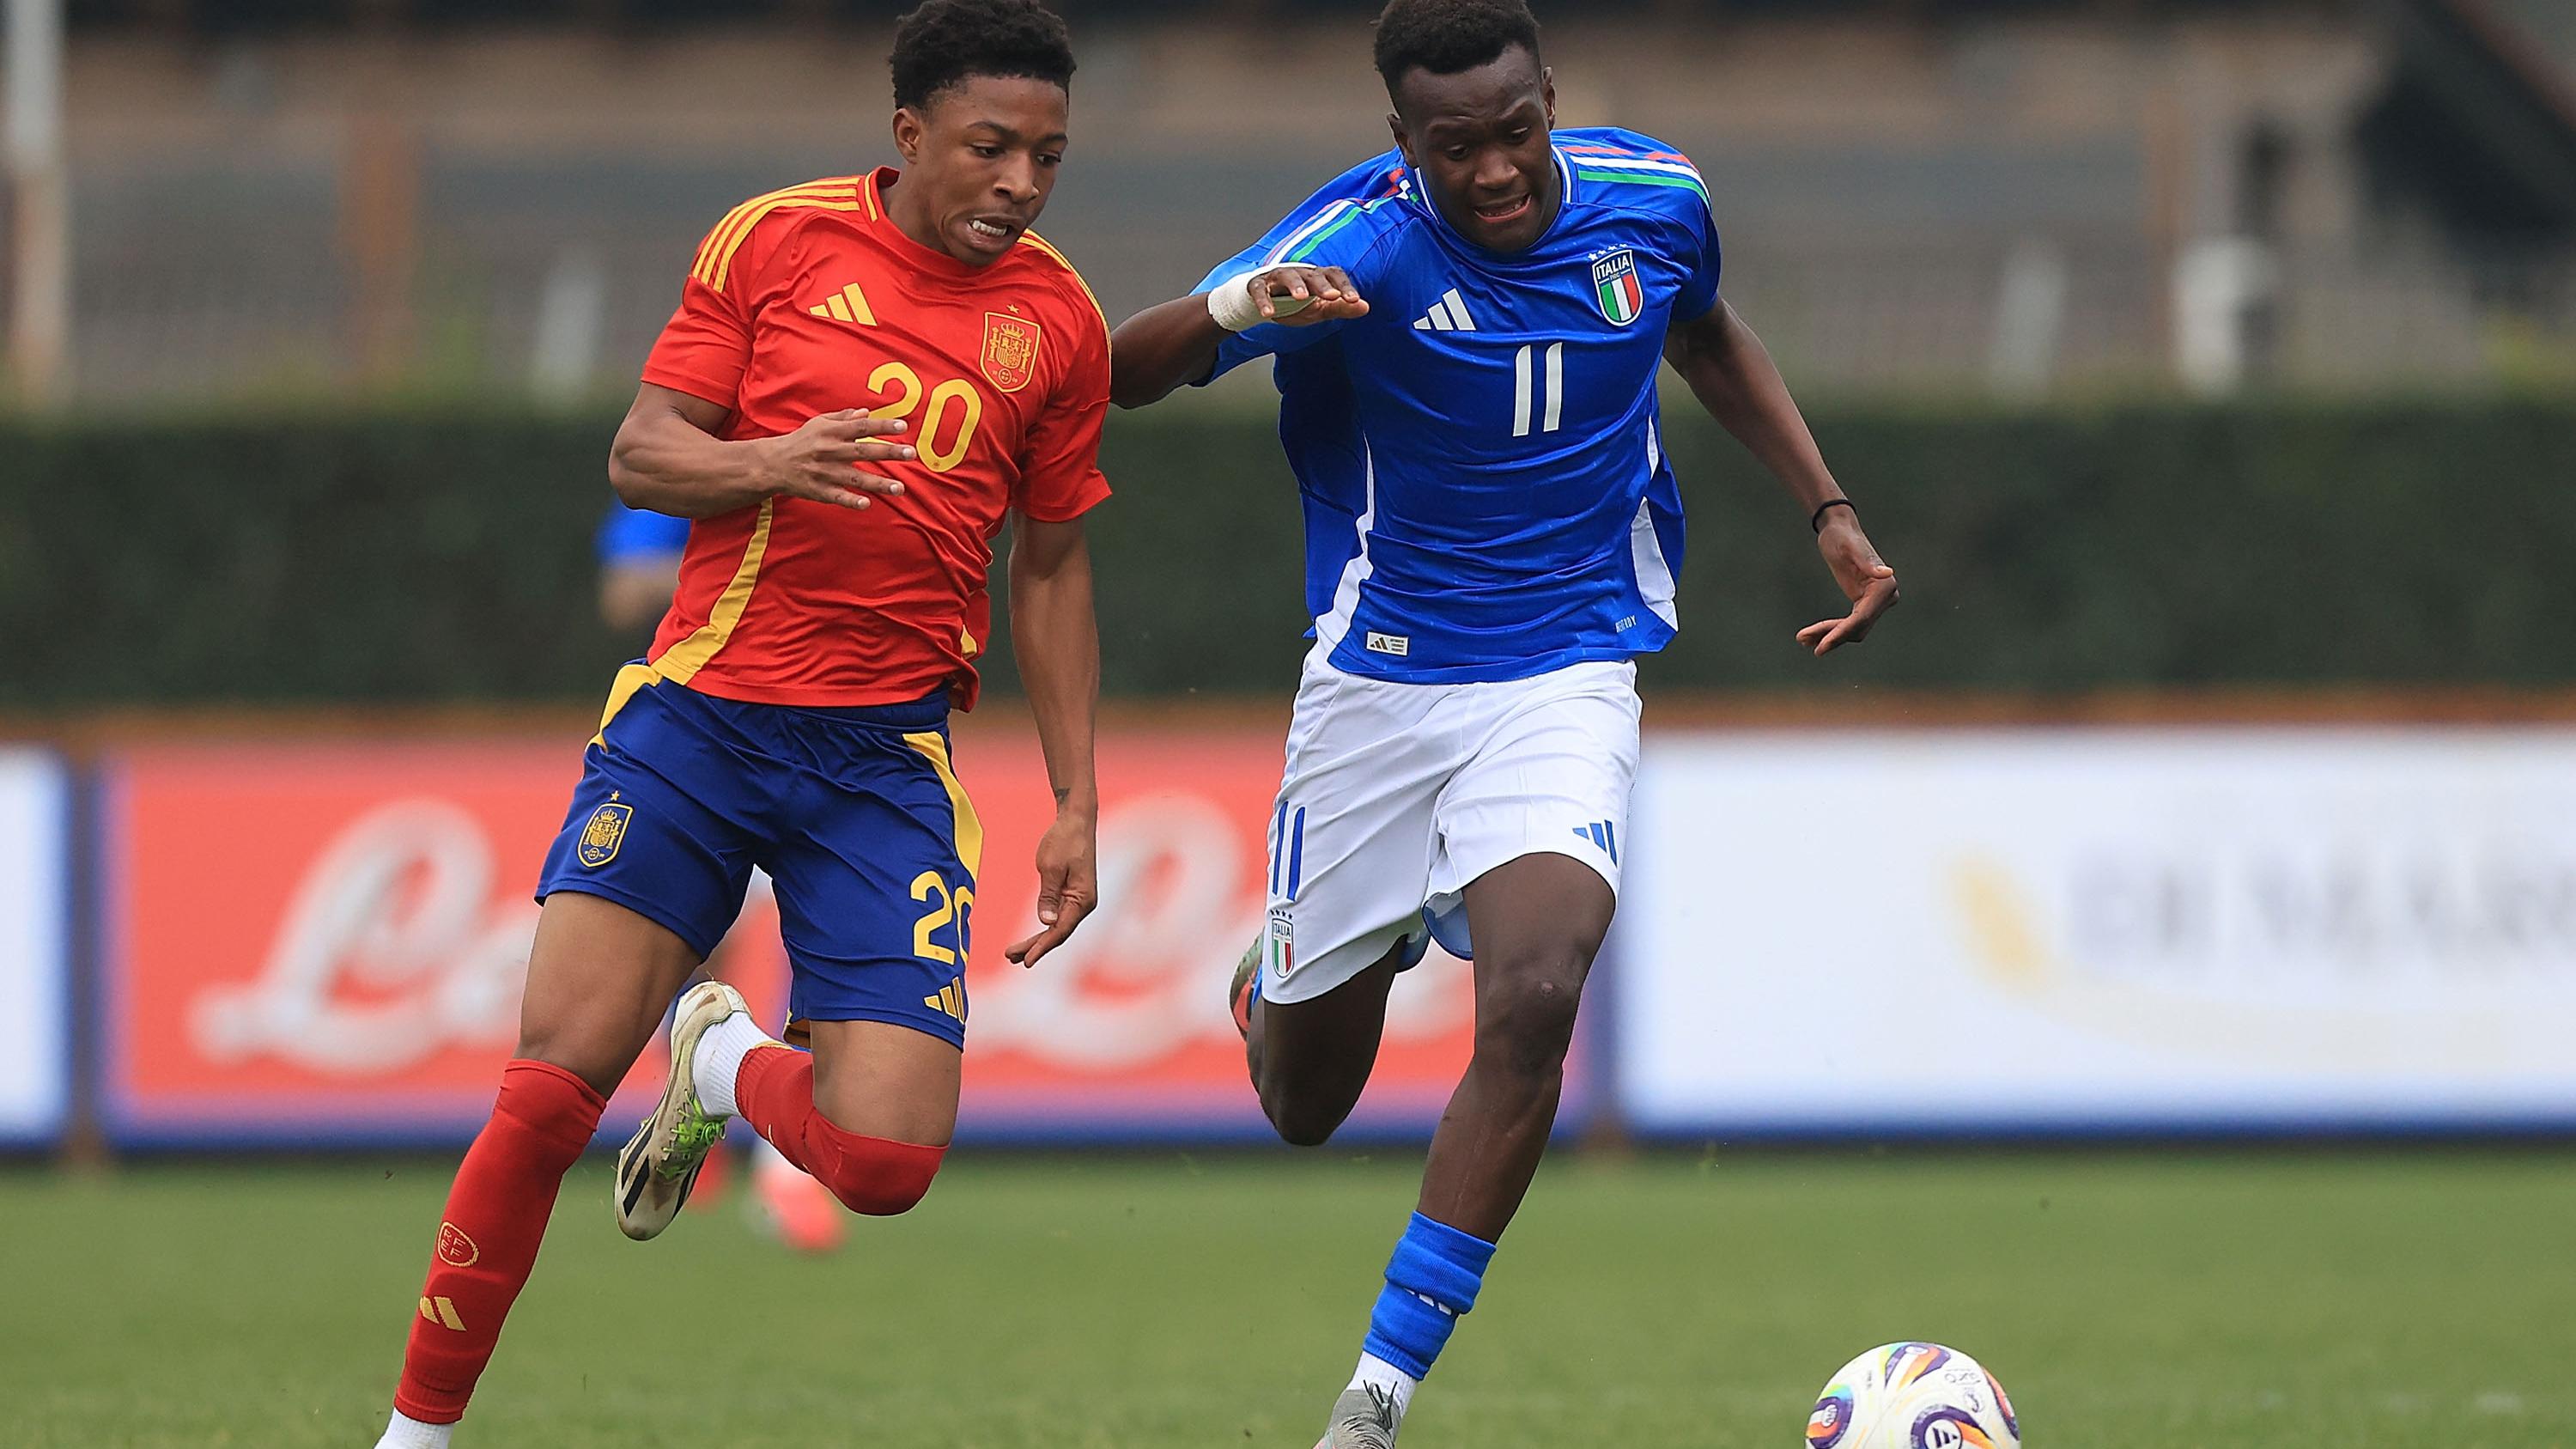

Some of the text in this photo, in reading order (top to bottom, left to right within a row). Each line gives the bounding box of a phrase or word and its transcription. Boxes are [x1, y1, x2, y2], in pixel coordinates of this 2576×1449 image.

[1595, 255, 1630, 279] ITALIA
[854, 361, 981, 473] 20
[1512, 342, 1563, 436] 11
[1272, 801, 1305, 902] 11
[910, 870, 975, 965] 20
